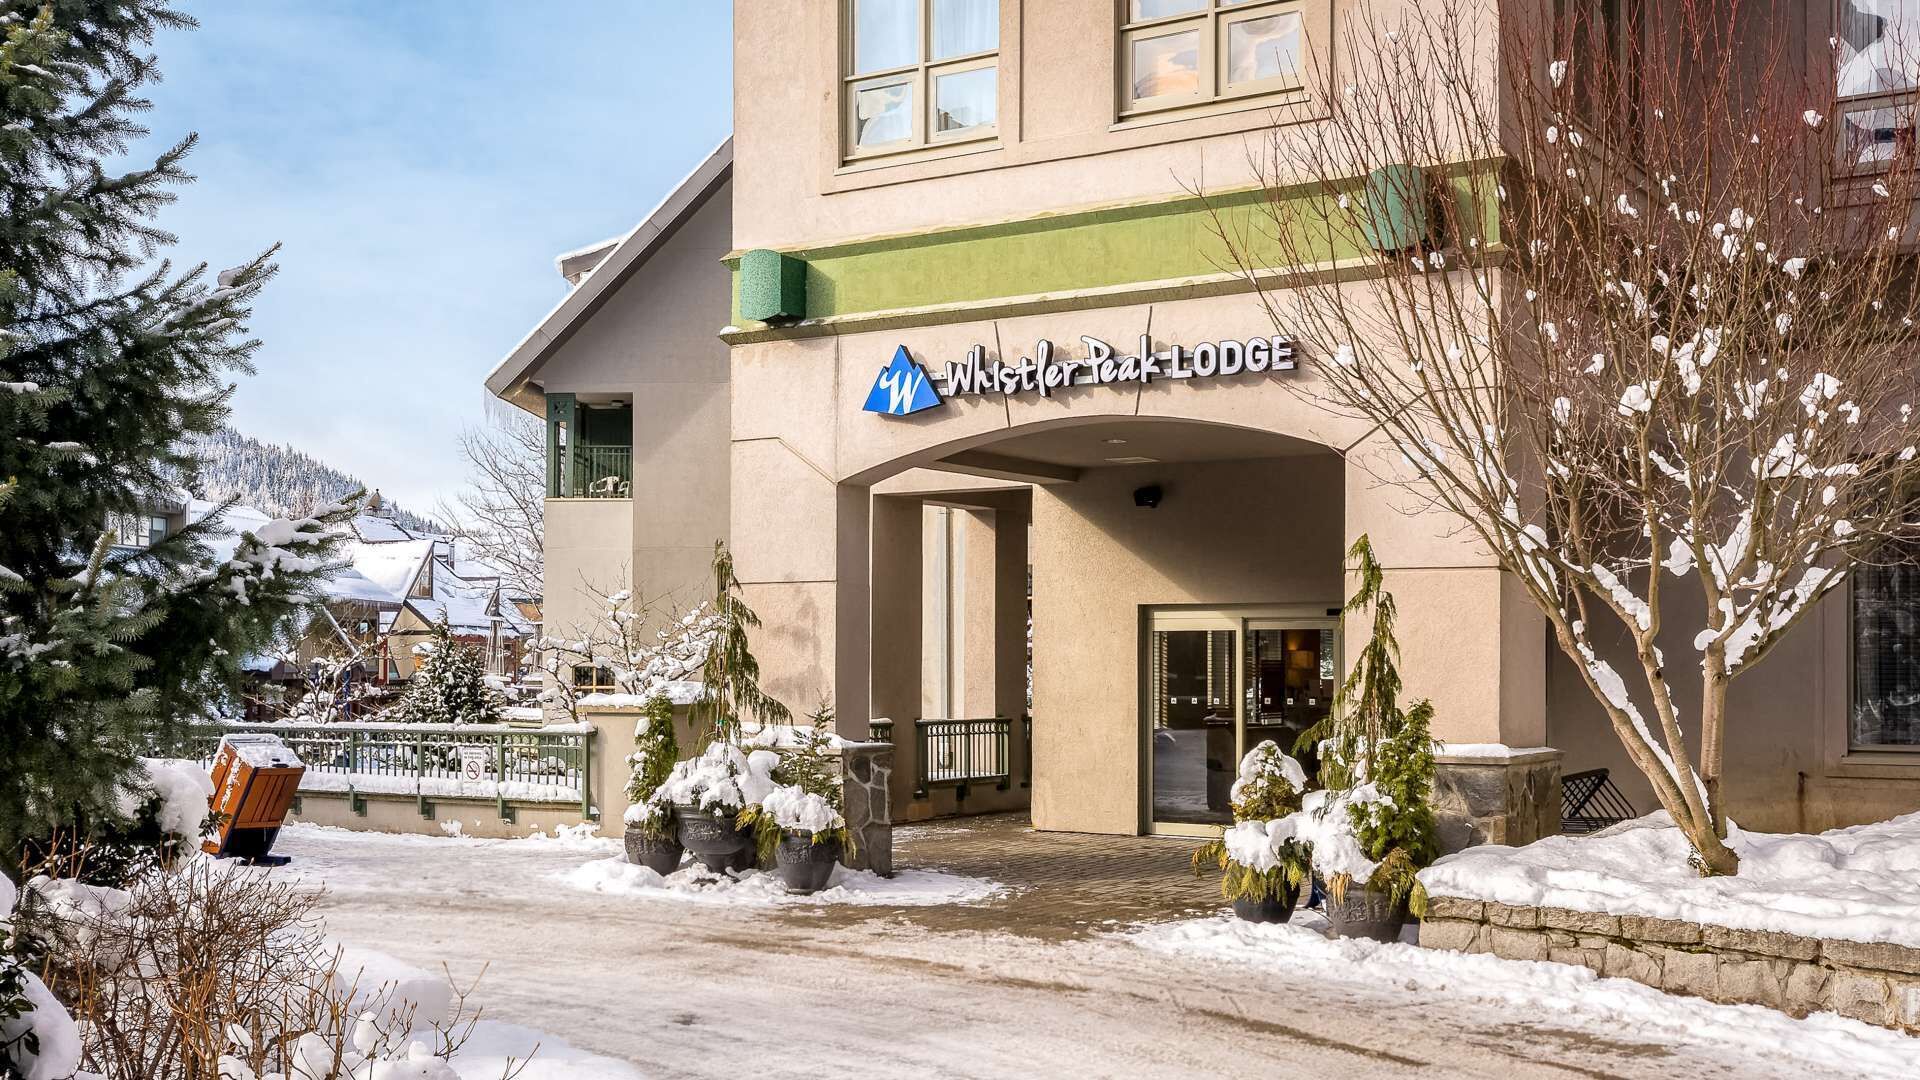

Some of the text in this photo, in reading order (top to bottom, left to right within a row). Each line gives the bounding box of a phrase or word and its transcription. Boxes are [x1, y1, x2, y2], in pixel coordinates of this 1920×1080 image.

[879, 370, 924, 413] W
[946, 334, 1296, 397] Whistler Peak LODGE
